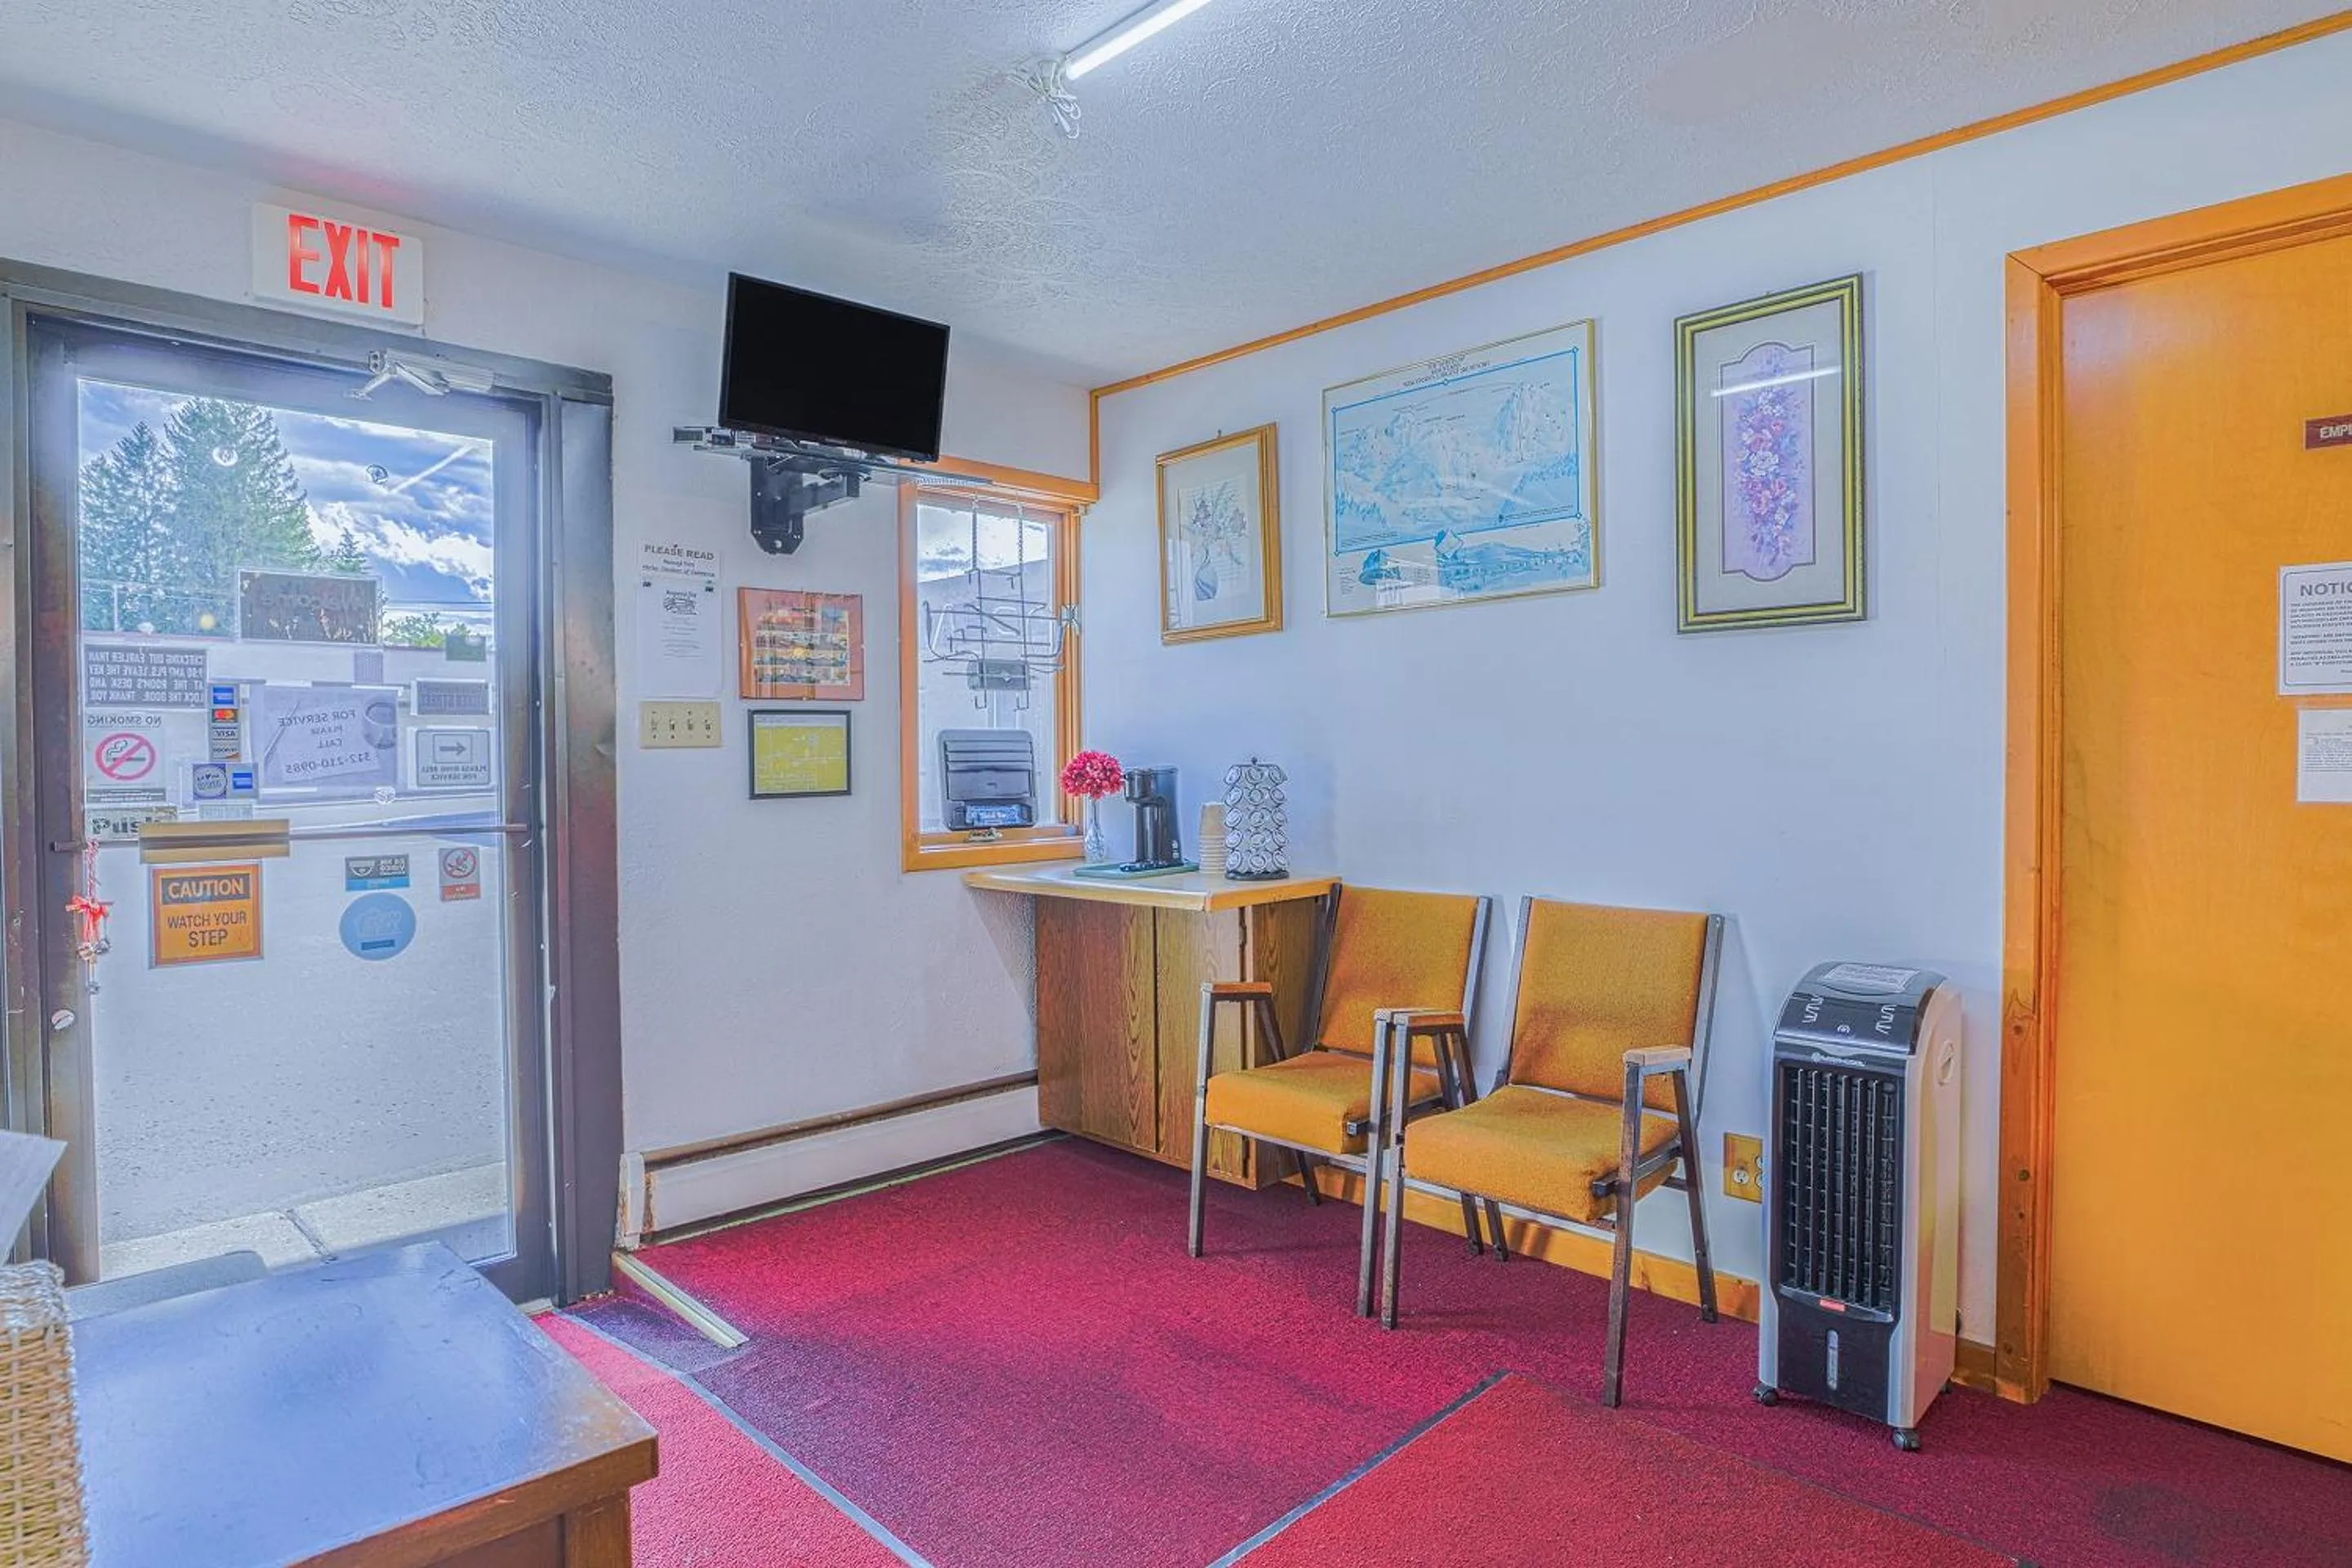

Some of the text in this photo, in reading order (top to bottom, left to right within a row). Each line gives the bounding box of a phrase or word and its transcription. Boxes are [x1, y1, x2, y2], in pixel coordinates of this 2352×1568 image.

[288, 214, 400, 309] EXIT
[644, 545, 714, 560] PLEASE READ
[168, 879, 244, 898] CAUTION
[167, 911, 247, 929] WATCH YOUR
[189, 929, 228, 947] STEP
